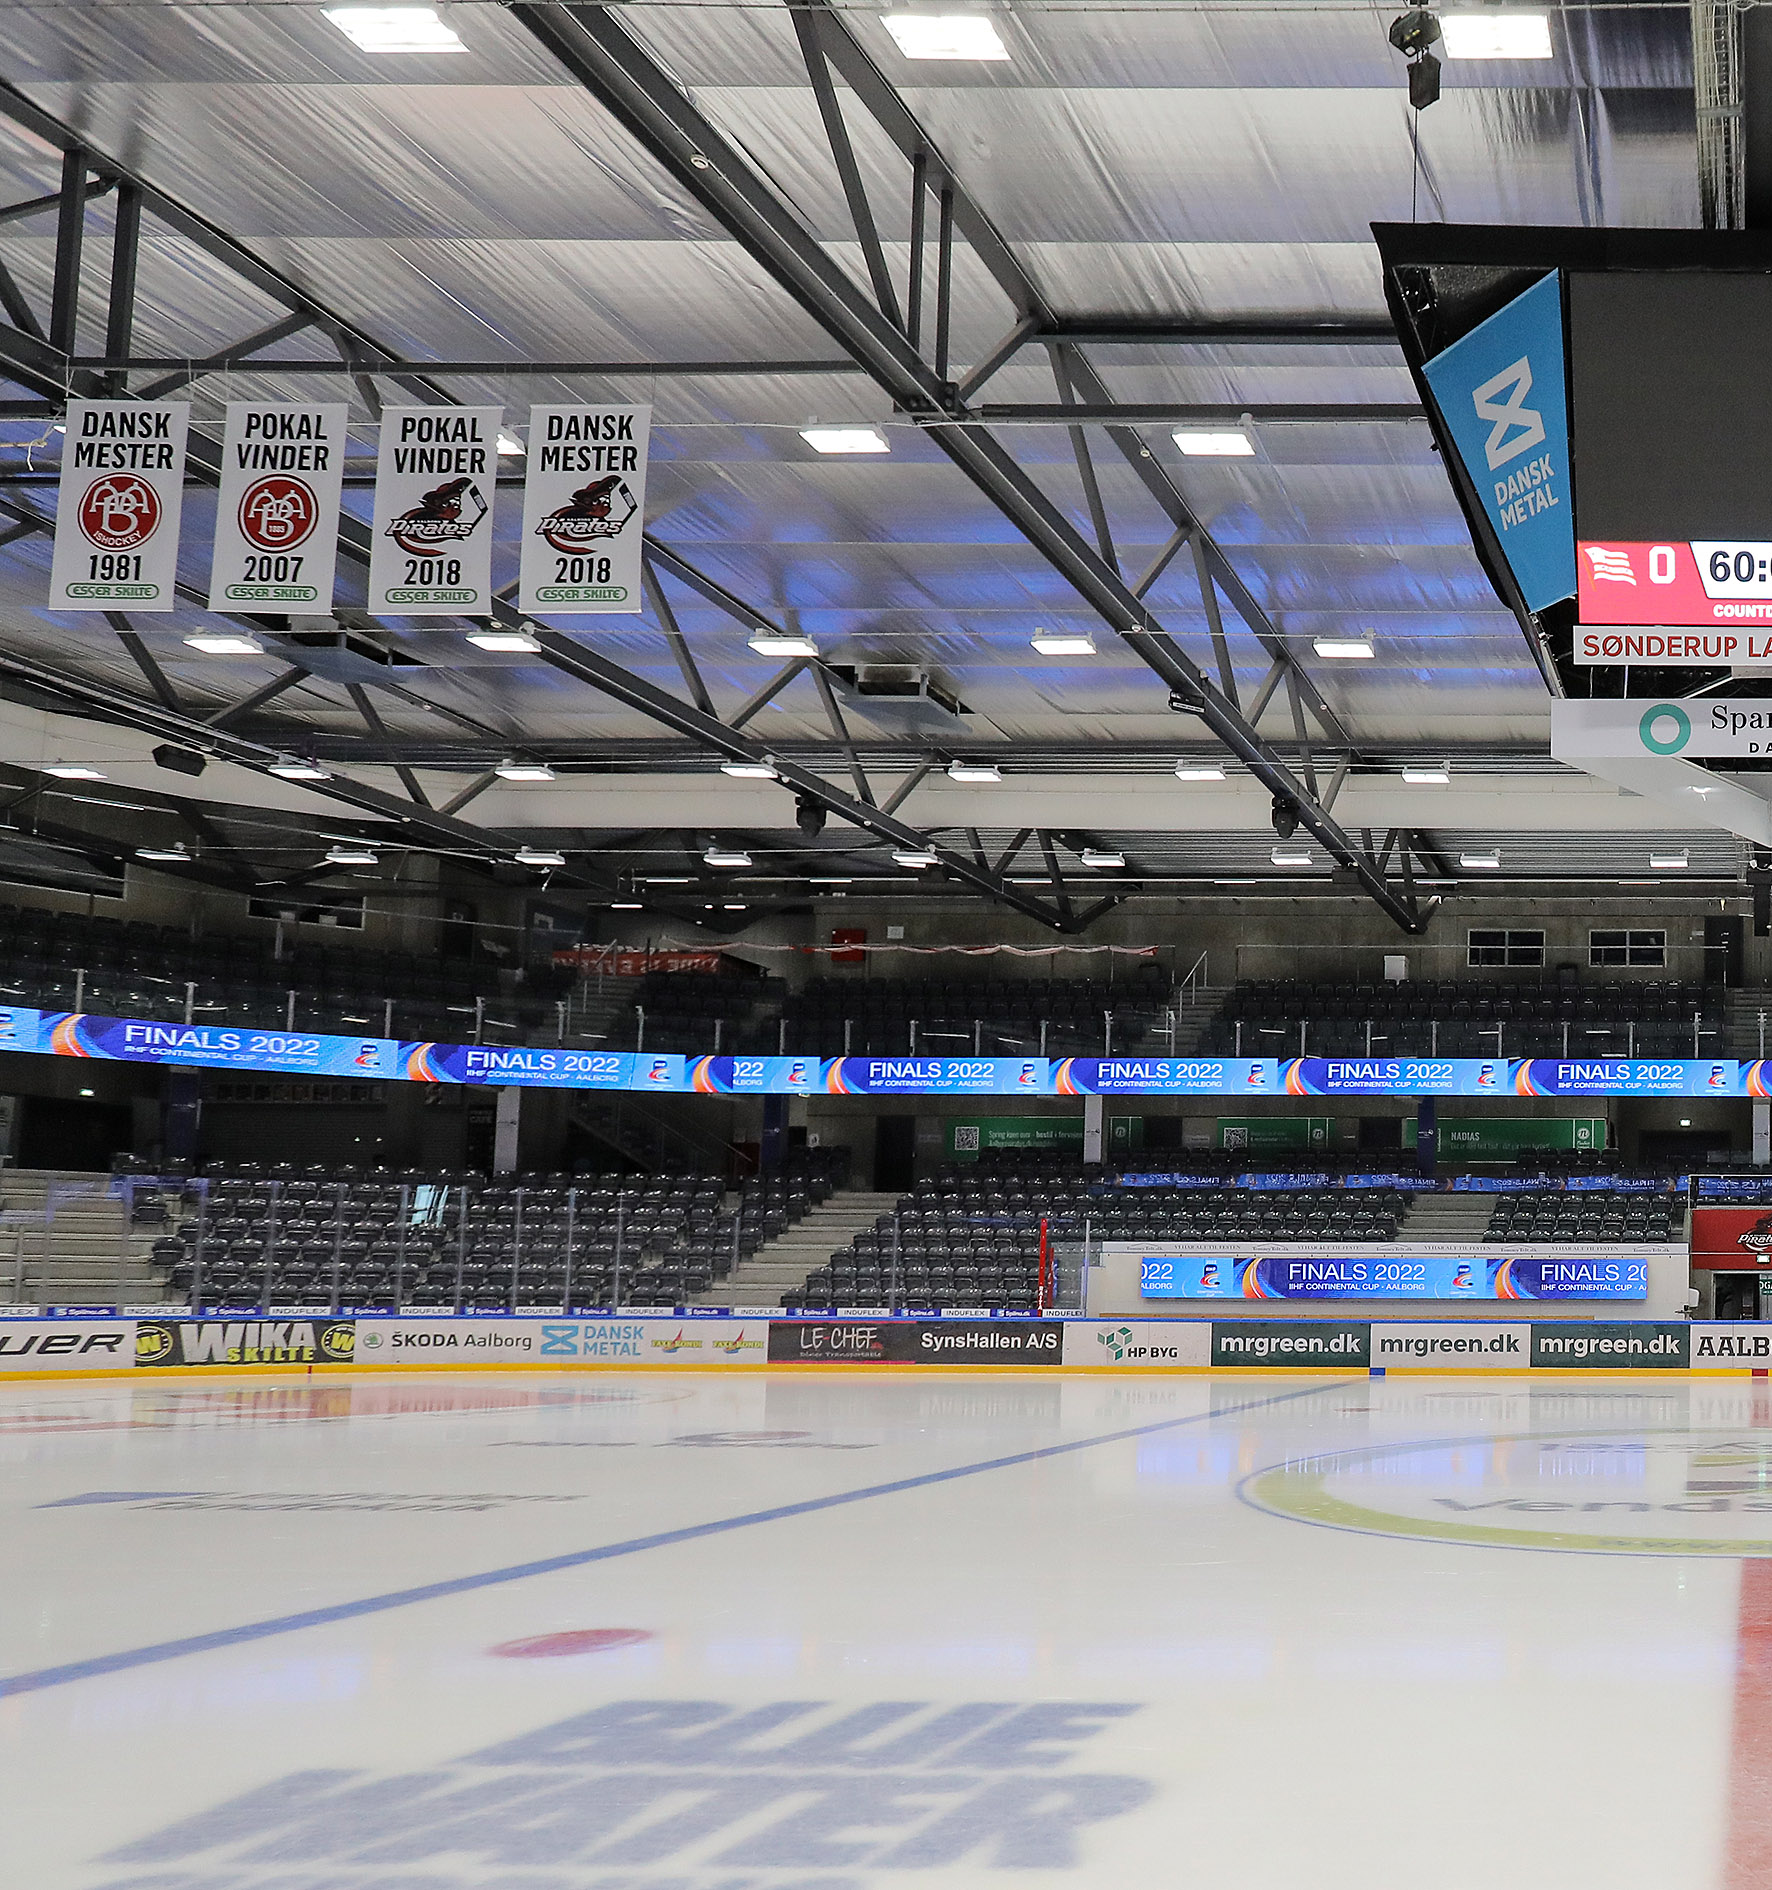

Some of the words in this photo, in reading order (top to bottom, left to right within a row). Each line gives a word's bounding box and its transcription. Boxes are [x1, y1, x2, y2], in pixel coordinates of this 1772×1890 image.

[82, 412, 171, 439] DANSK
[245, 413, 328, 440] POKAL
[400, 417, 483, 442] POKAL
[548, 415, 634, 440] DANSK
[74, 442, 173, 470] MESTER
[237, 444, 328, 471] VINDER
[394, 448, 486, 474] VINDER
[541, 446, 637, 472] MESTER
[1493, 453, 1555, 508] DANSK
[1498, 485, 1560, 533] METAL
[93, 530, 142, 546] ISHOCKEY
[89, 555, 142, 582] 1981
[243, 556, 304, 583] 2007
[404, 560, 461, 585] 2018
[555, 558, 611, 583] 2018
[1648, 546, 1676, 586] 0
[73, 586, 111, 597] ESSER
[115, 587, 152, 597] SKILTE
[233, 588, 269, 599] ESSER
[273, 588, 310, 599] SKILTE
[392, 590, 430, 601] ESSER
[433, 590, 470, 601] SKILTE
[543, 588, 580, 599] ESSER
[583, 588, 621, 599] SKILTE
[1582, 634, 1738, 659] SØNDERUP
[125, 1024, 241, 1051] FINALS
[250, 1036, 321, 1056] 2022
[466, 1051, 555, 1071] FINALS
[563, 1055, 620, 1073] 2022
[870, 1063, 941, 1078] FINALS
[948, 1063, 994, 1078] 2022
[1098, 1063, 1170, 1078] FINALS
[1176, 1063, 1223, 1078] 2022
[1328, 1064, 1400, 1079] FINALS
[1406, 1064, 1453, 1079] 2022
[1558, 1064, 1630, 1080] FINALS
[1636, 1064, 1684, 1080] 2022
[1450, 1130, 1480, 1141] NADIAS
[1289, 1263, 1367, 1280] FINALS
[1375, 1263, 1426, 1280] 2022
[1541, 1264, 1620, 1281] FINALS
[271, 1307, 328, 1316] INDUFLEX
[402, 1307, 452, 1316] INDUFLEX
[180, 1323, 317, 1363] WIKA
[392, 1331, 458, 1347] ŠKODA
[464, 1333, 532, 1350] Aalborg
[585, 1326, 645, 1340] DANSK
[921, 1332, 1022, 1351] SynsHallen
[1026, 1333, 1058, 1350] A/S
[227, 1347, 314, 1362] SKILTE
[583, 1341, 641, 1356] METAL
[1128, 1347, 1148, 1358] HP
[1150, 1347, 1178, 1358] BYG
[1221, 1333, 1361, 1357] mrgreen.dk
[1380, 1334, 1520, 1357] mrgreen.dk
[1539, 1334, 1681, 1357] mrgreen.dk
[450, 1699, 1149, 1768] BLUE
[77, 1767, 1159, 1870] WATER
